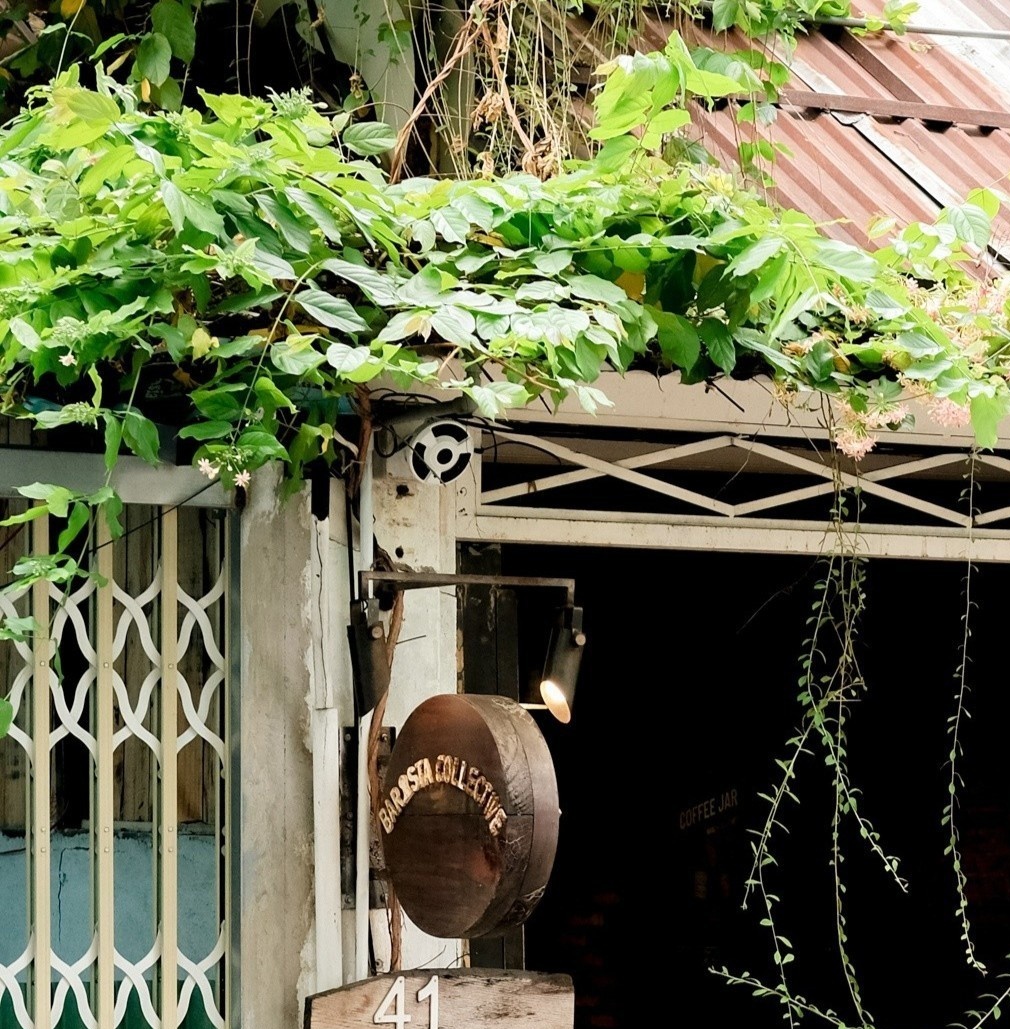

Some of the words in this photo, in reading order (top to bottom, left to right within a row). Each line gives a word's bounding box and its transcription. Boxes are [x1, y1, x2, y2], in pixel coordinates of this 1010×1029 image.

[378, 757, 435, 835] BARISTA
[435, 754, 508, 837] COLLECTIVE
[679, 797, 716, 830] COFFEE
[718, 788, 739, 813] JAR
